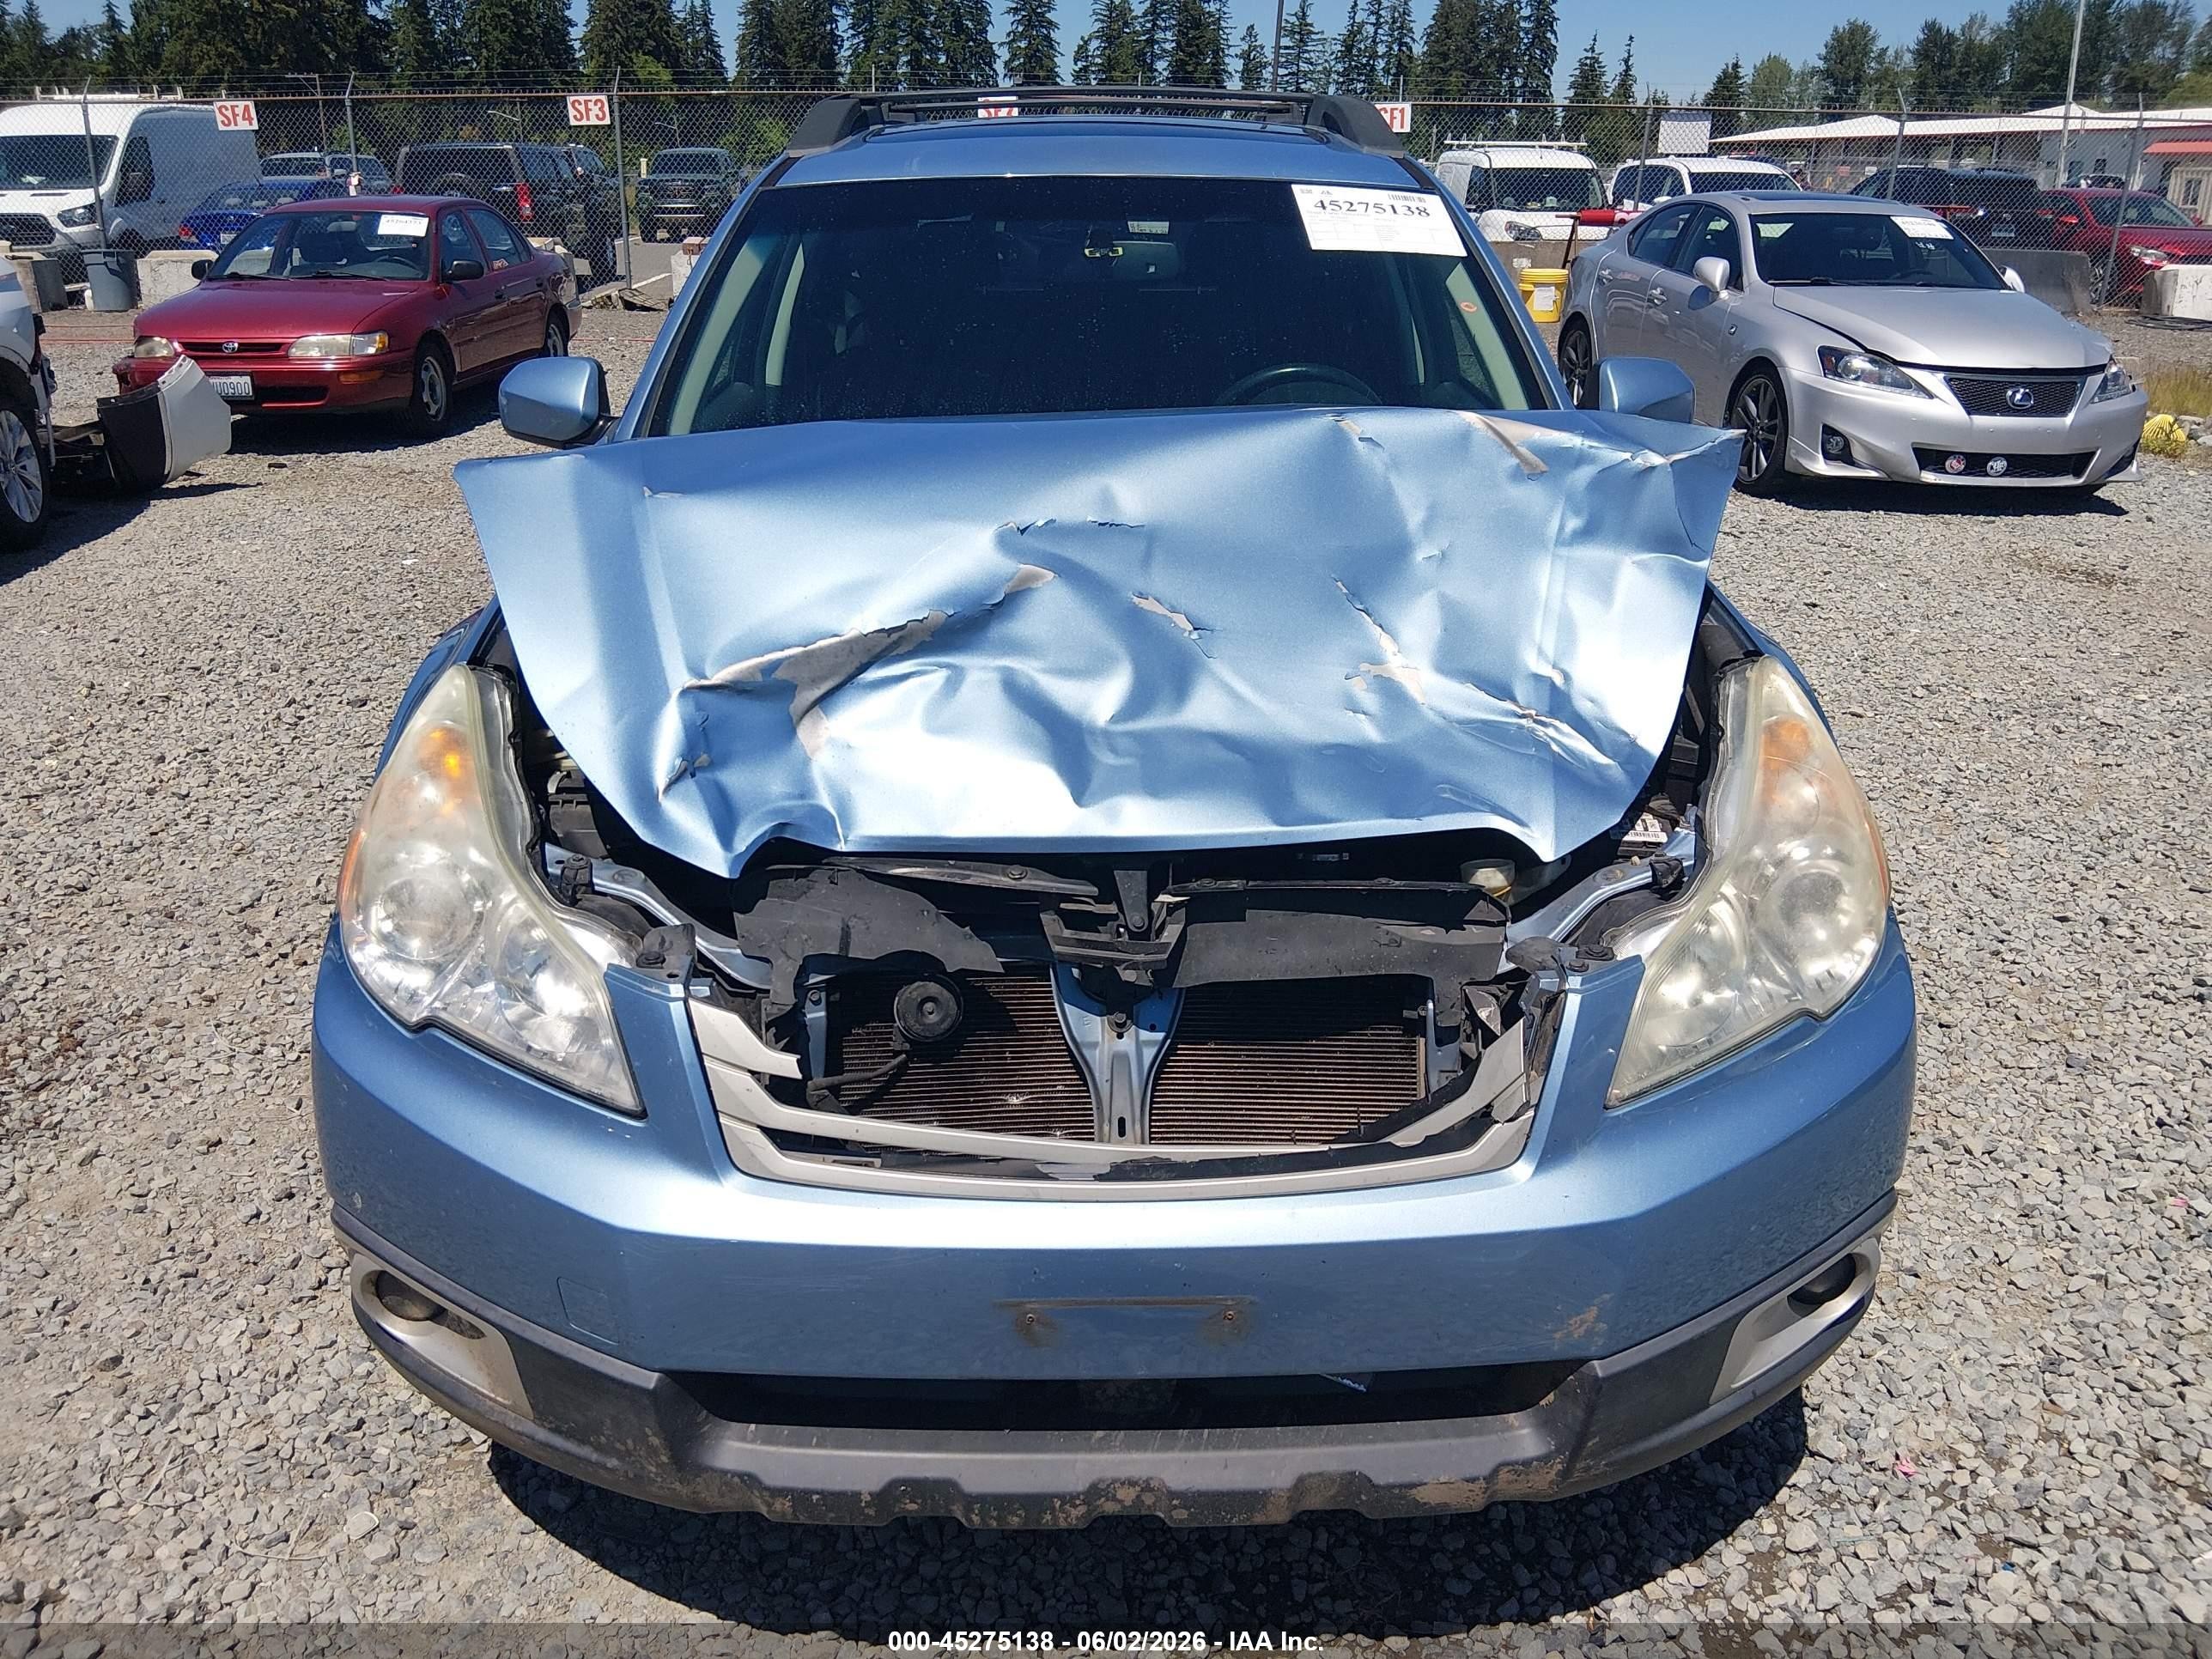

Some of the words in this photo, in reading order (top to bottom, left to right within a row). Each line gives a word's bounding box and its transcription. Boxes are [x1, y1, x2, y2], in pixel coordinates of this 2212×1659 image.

[218, 104, 254, 127] SF4
[570, 99, 606, 122] SF3
[1314, 199, 1431, 217] 45275138
